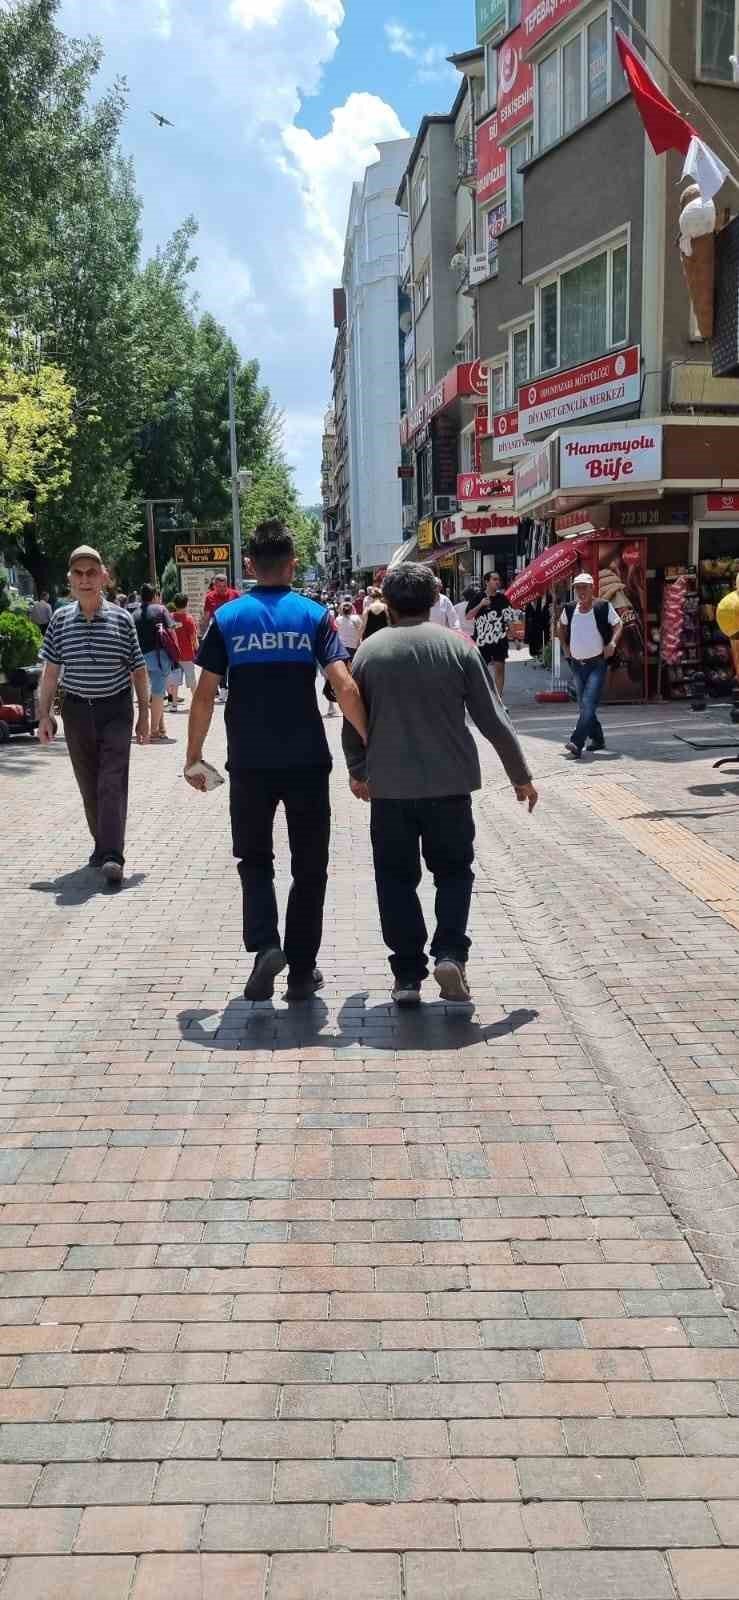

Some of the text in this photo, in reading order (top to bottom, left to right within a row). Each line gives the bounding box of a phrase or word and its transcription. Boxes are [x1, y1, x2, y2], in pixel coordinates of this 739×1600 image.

[528, 383, 625, 425] DİYANET GENÇLİK MERKEZİ
[565, 435, 655, 456] Hamamyolu
[585, 457, 634, 481] Büfe
[232, 631, 312, 653] ZABITA
